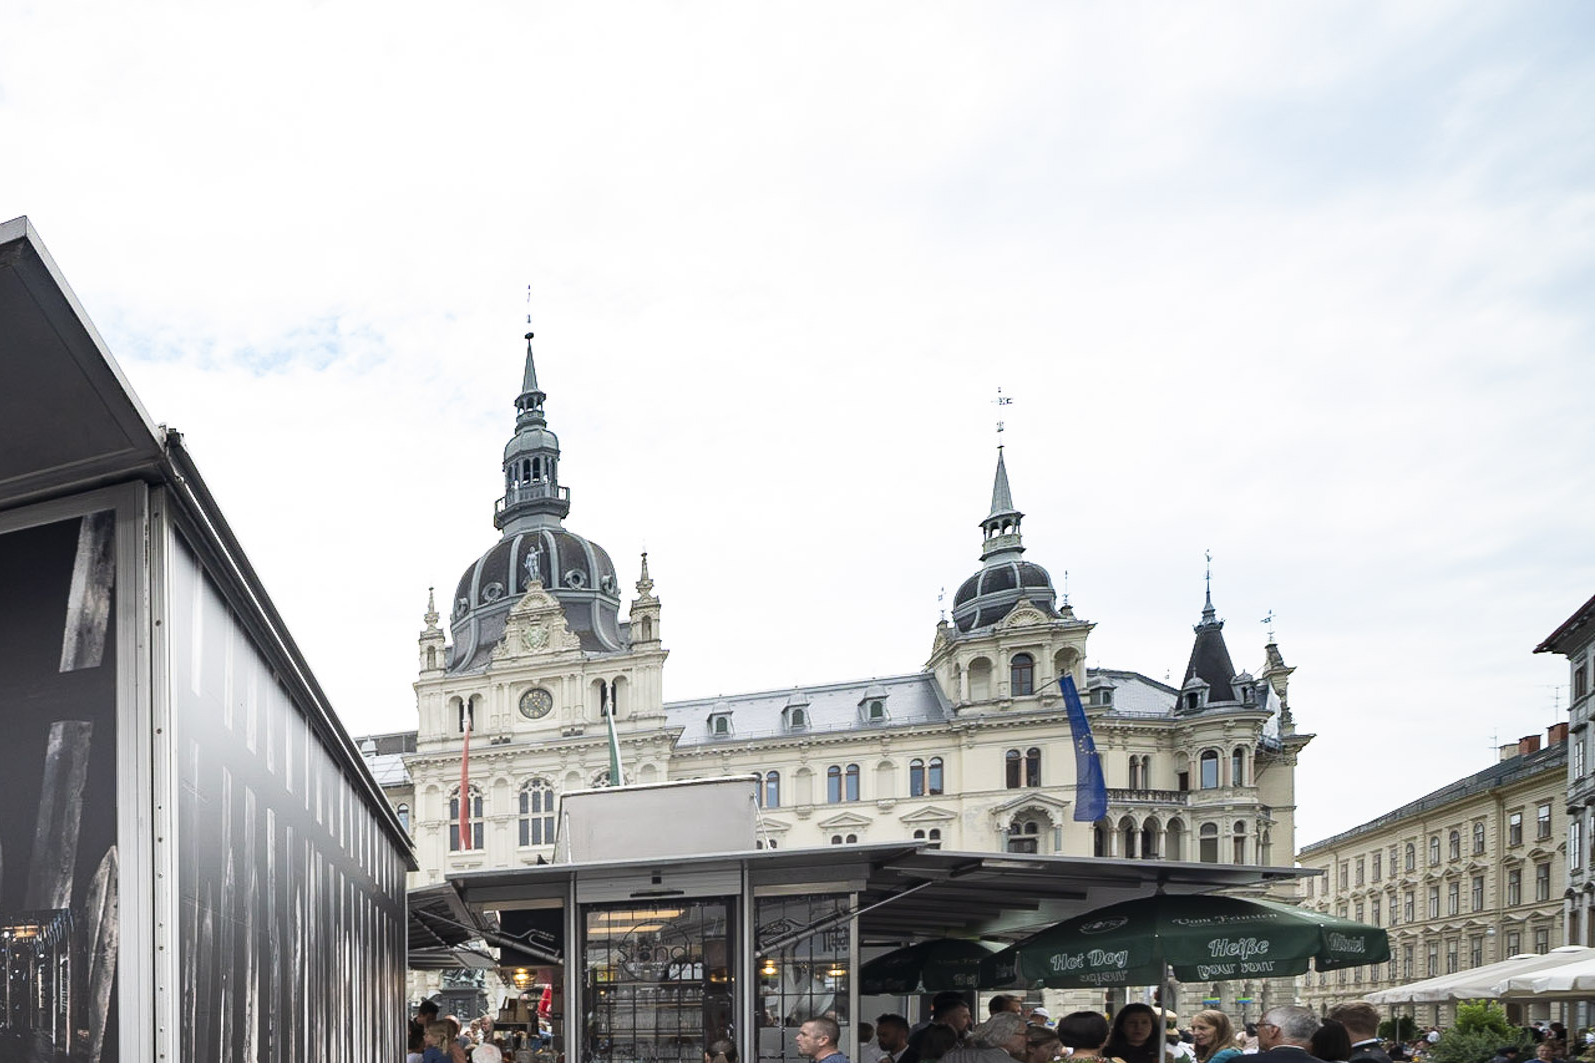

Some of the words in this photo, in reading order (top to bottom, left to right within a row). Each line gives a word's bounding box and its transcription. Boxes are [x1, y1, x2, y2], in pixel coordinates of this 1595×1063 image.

[1208, 937, 1270, 960] Heiße
[1050, 953, 1085, 971] Hot
[1086, 949, 1128, 969] Dog
